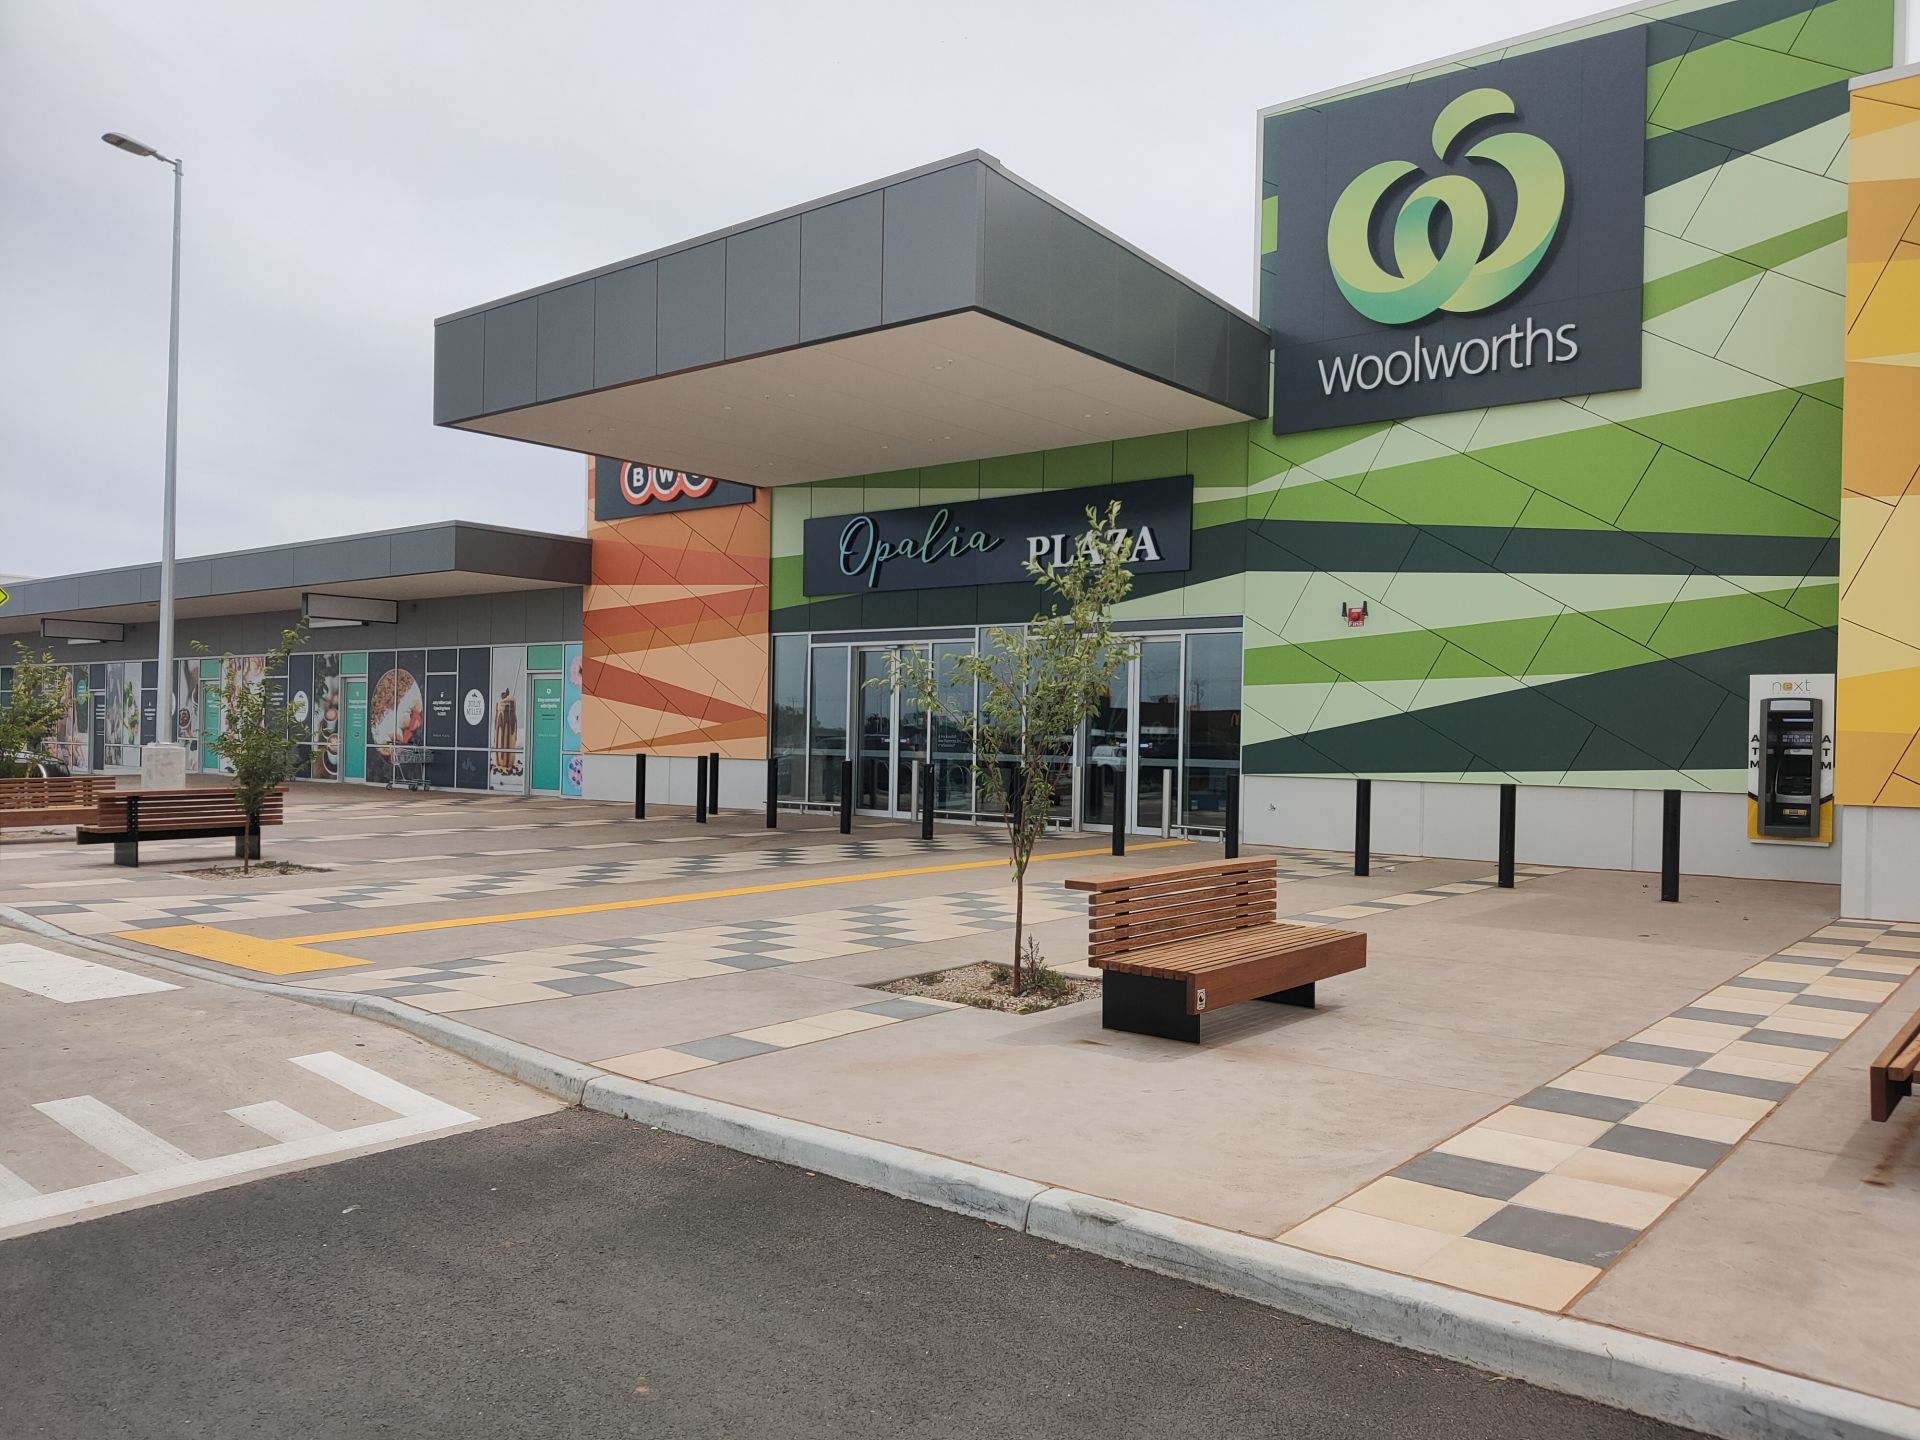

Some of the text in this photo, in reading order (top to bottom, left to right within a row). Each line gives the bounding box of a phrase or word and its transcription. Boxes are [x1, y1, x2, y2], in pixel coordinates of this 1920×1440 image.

[839, 508, 1161, 588] Opalia PLAZA
[1750, 734, 1760, 769] ATM
[1820, 735, 1832, 771] ATM
